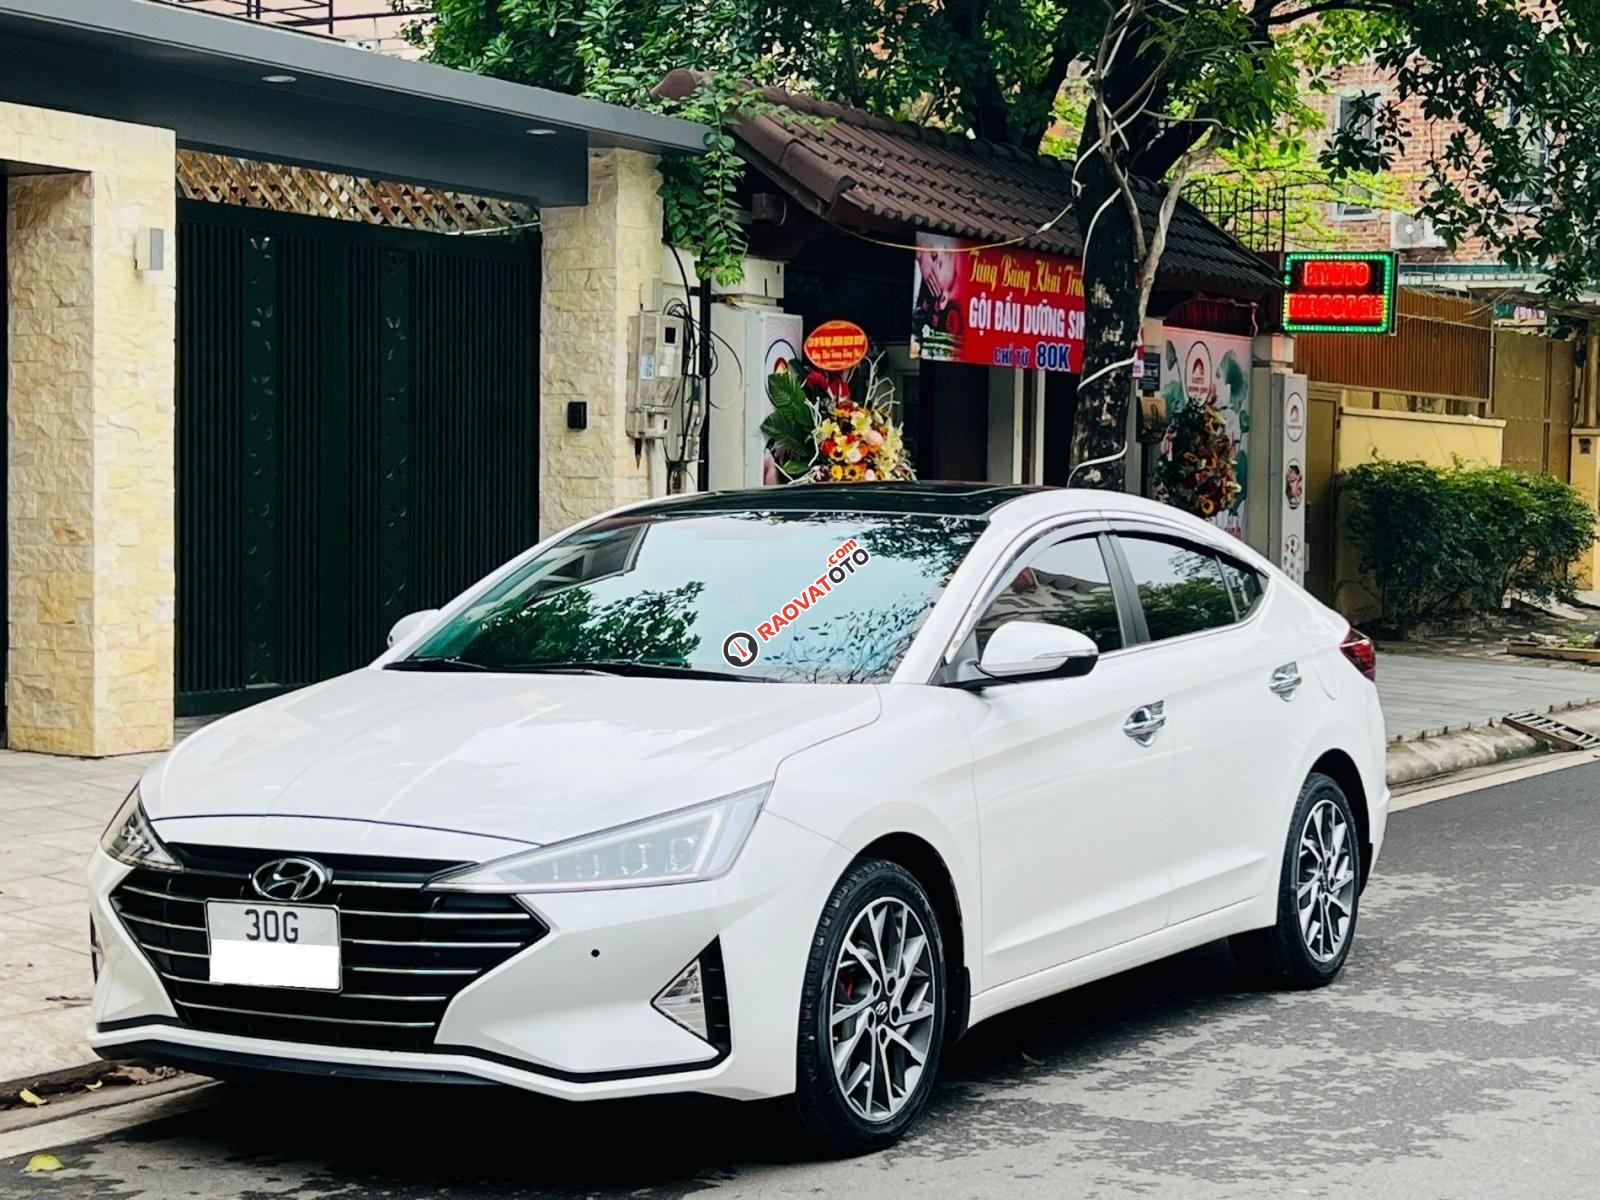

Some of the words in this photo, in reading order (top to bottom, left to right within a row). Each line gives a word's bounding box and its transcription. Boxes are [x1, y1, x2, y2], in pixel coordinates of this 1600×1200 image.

[1032, 260, 1061, 294] Khai
[968, 292, 992, 336] GỘI
[1022, 298, 1066, 338] DƯỠNG
[1035, 341, 1072, 371] 80K
[244, 908, 299, 944] 30G
